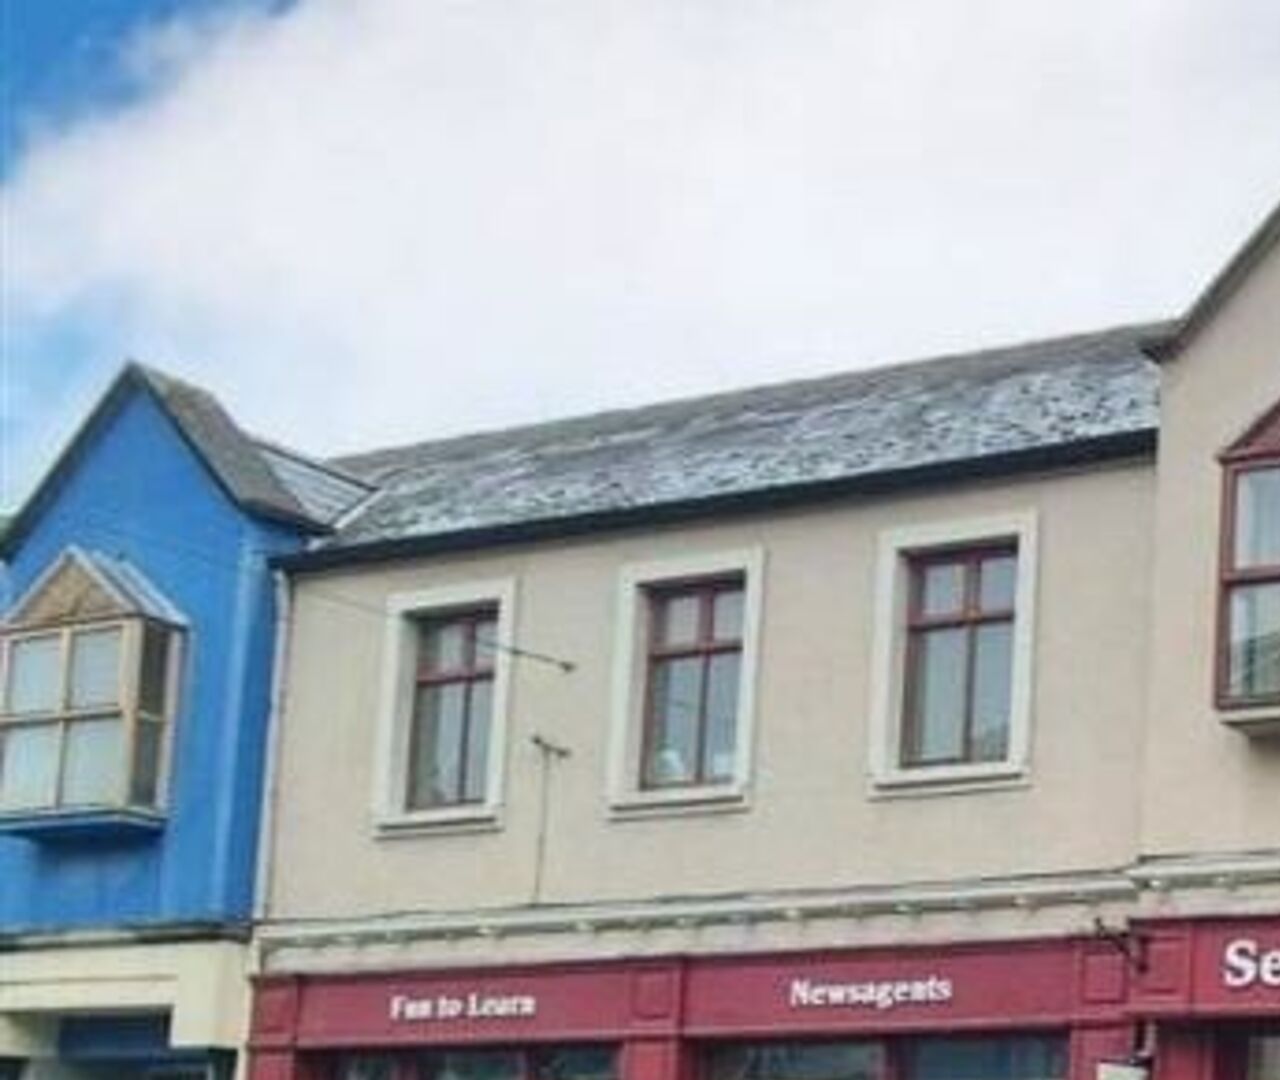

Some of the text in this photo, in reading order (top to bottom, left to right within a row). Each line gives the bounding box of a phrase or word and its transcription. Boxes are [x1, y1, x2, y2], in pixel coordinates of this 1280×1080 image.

[389, 992, 536, 1020] Fun to Learn
[789, 975, 953, 1009] Newsagents
